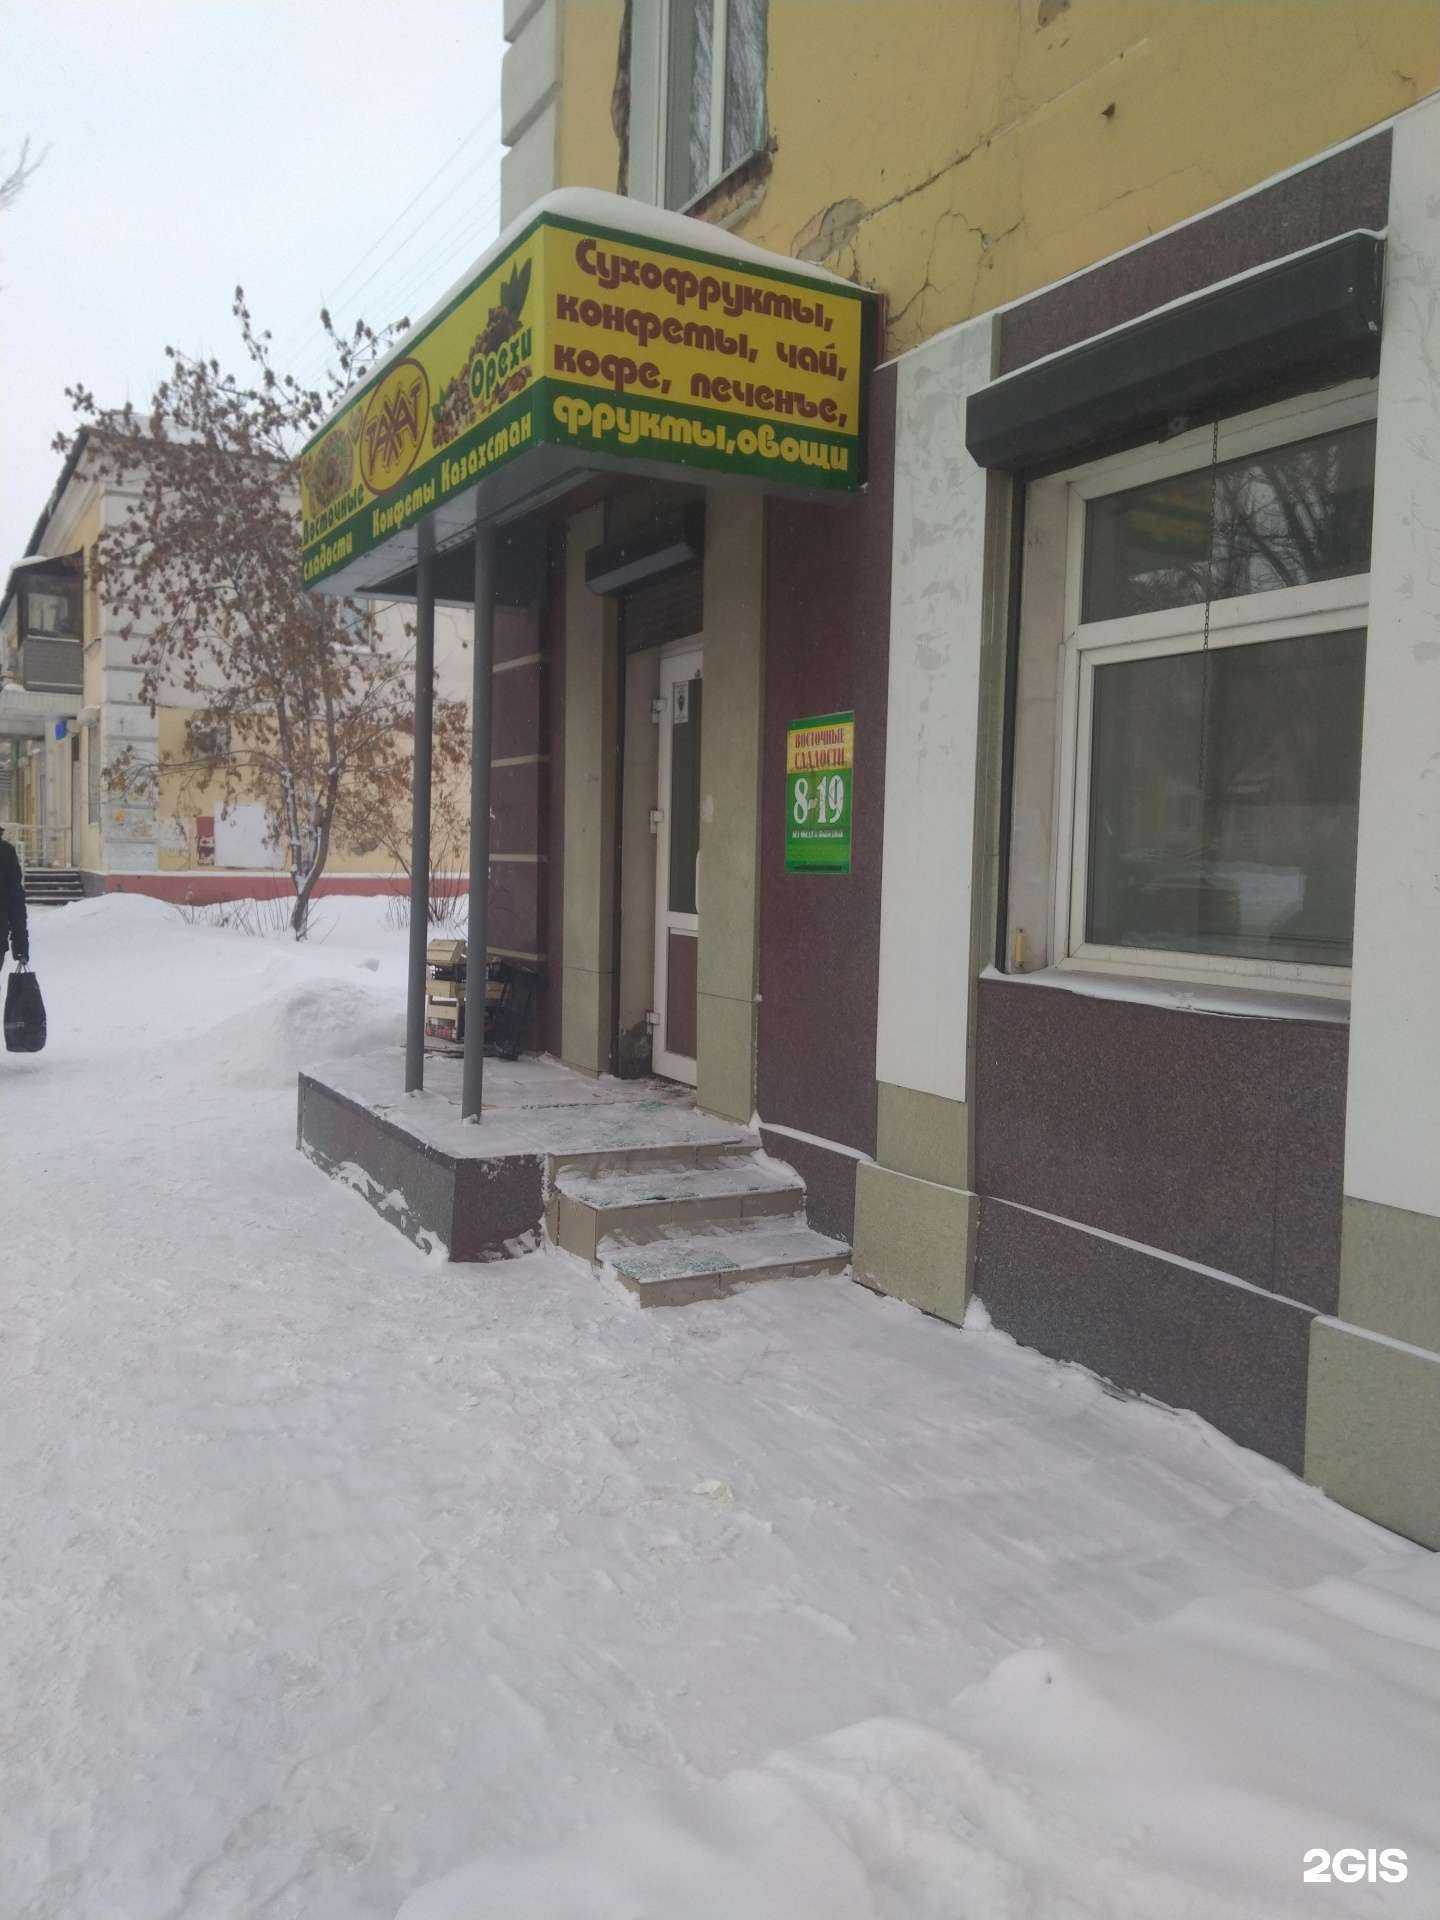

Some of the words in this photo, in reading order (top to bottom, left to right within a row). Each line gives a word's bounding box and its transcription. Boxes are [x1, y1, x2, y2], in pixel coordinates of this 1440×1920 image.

[575, 239, 834, 332] Сухофрукты,
[469, 327, 532, 400] Орехи
[554, 344, 672, 394] кофе,
[556, 293, 759, 363] конфеты,
[776, 341, 848, 381] чай,
[372, 476, 436, 538] Конфеты
[441, 412, 532, 493] Казахстан
[303, 484, 365, 545] Восточные
[303, 531, 353, 582] сладости
[793, 775, 845, 825] 8-19
